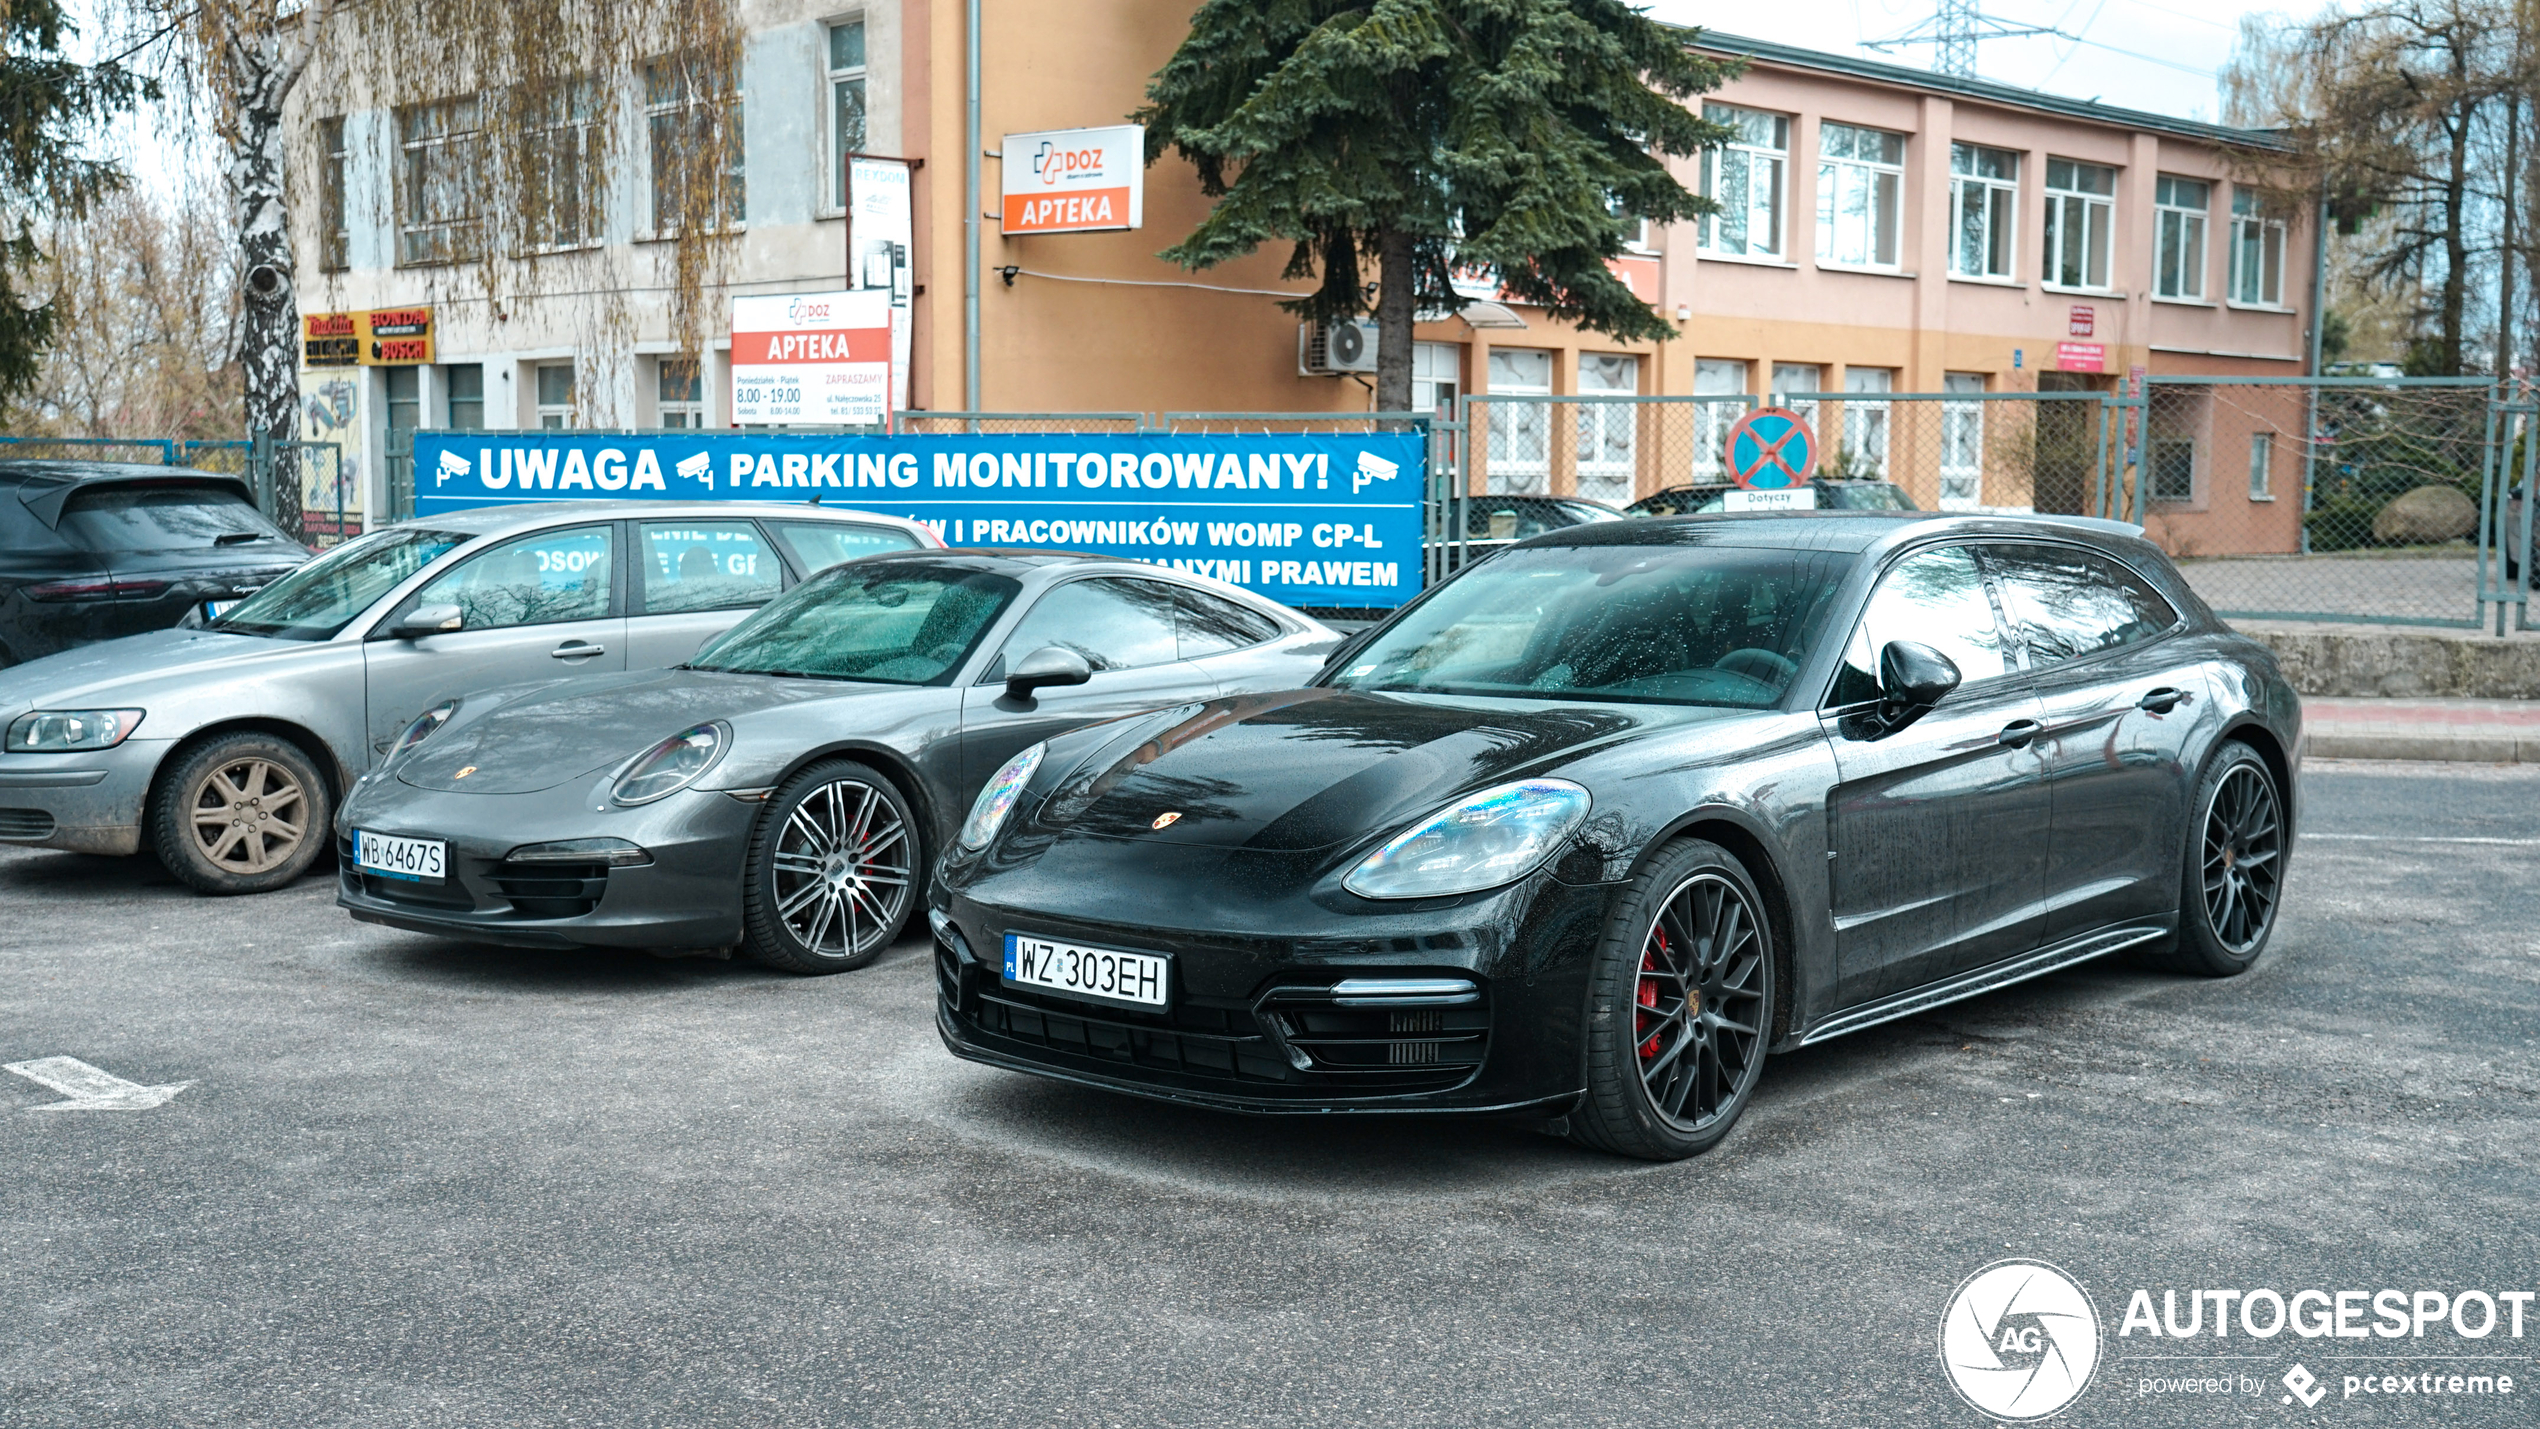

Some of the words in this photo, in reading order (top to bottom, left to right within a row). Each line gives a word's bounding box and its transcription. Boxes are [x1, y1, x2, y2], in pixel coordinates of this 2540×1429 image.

[1066, 149, 1103, 171] DOZ
[1020, 196, 1113, 226] APTEKA
[370, 310, 429, 327] HONDA
[808, 304, 830, 317] DOZ
[381, 340, 426, 359] BOSCH
[767, 334, 850, 360] APTEKA
[826, 374, 883, 385] ZAPRASZAMY
[737, 388, 761, 403] 8.00
[771, 388, 801, 403] 19.00
[479, 448, 668, 491] UWAGA
[730, 453, 919, 489] PARKING
[933, 452, 1330, 490] MONITOROWANY!
[1748, 493, 1791, 504] Dotyczy
[973, 516, 1200, 546] PRACOWNIKÓW
[1207, 522, 1303, 547] WOMP
[1312, 523, 1383, 549] CP-L
[1261, 561, 1398, 587] PRAWEM
[361, 835, 380, 864] WB
[385, 840, 441, 873] 6467S
[1006, 961, 1015, 973] PL
[1022, 941, 1054, 983] WZ
[1065, 949, 1158, 1000] 303EH
